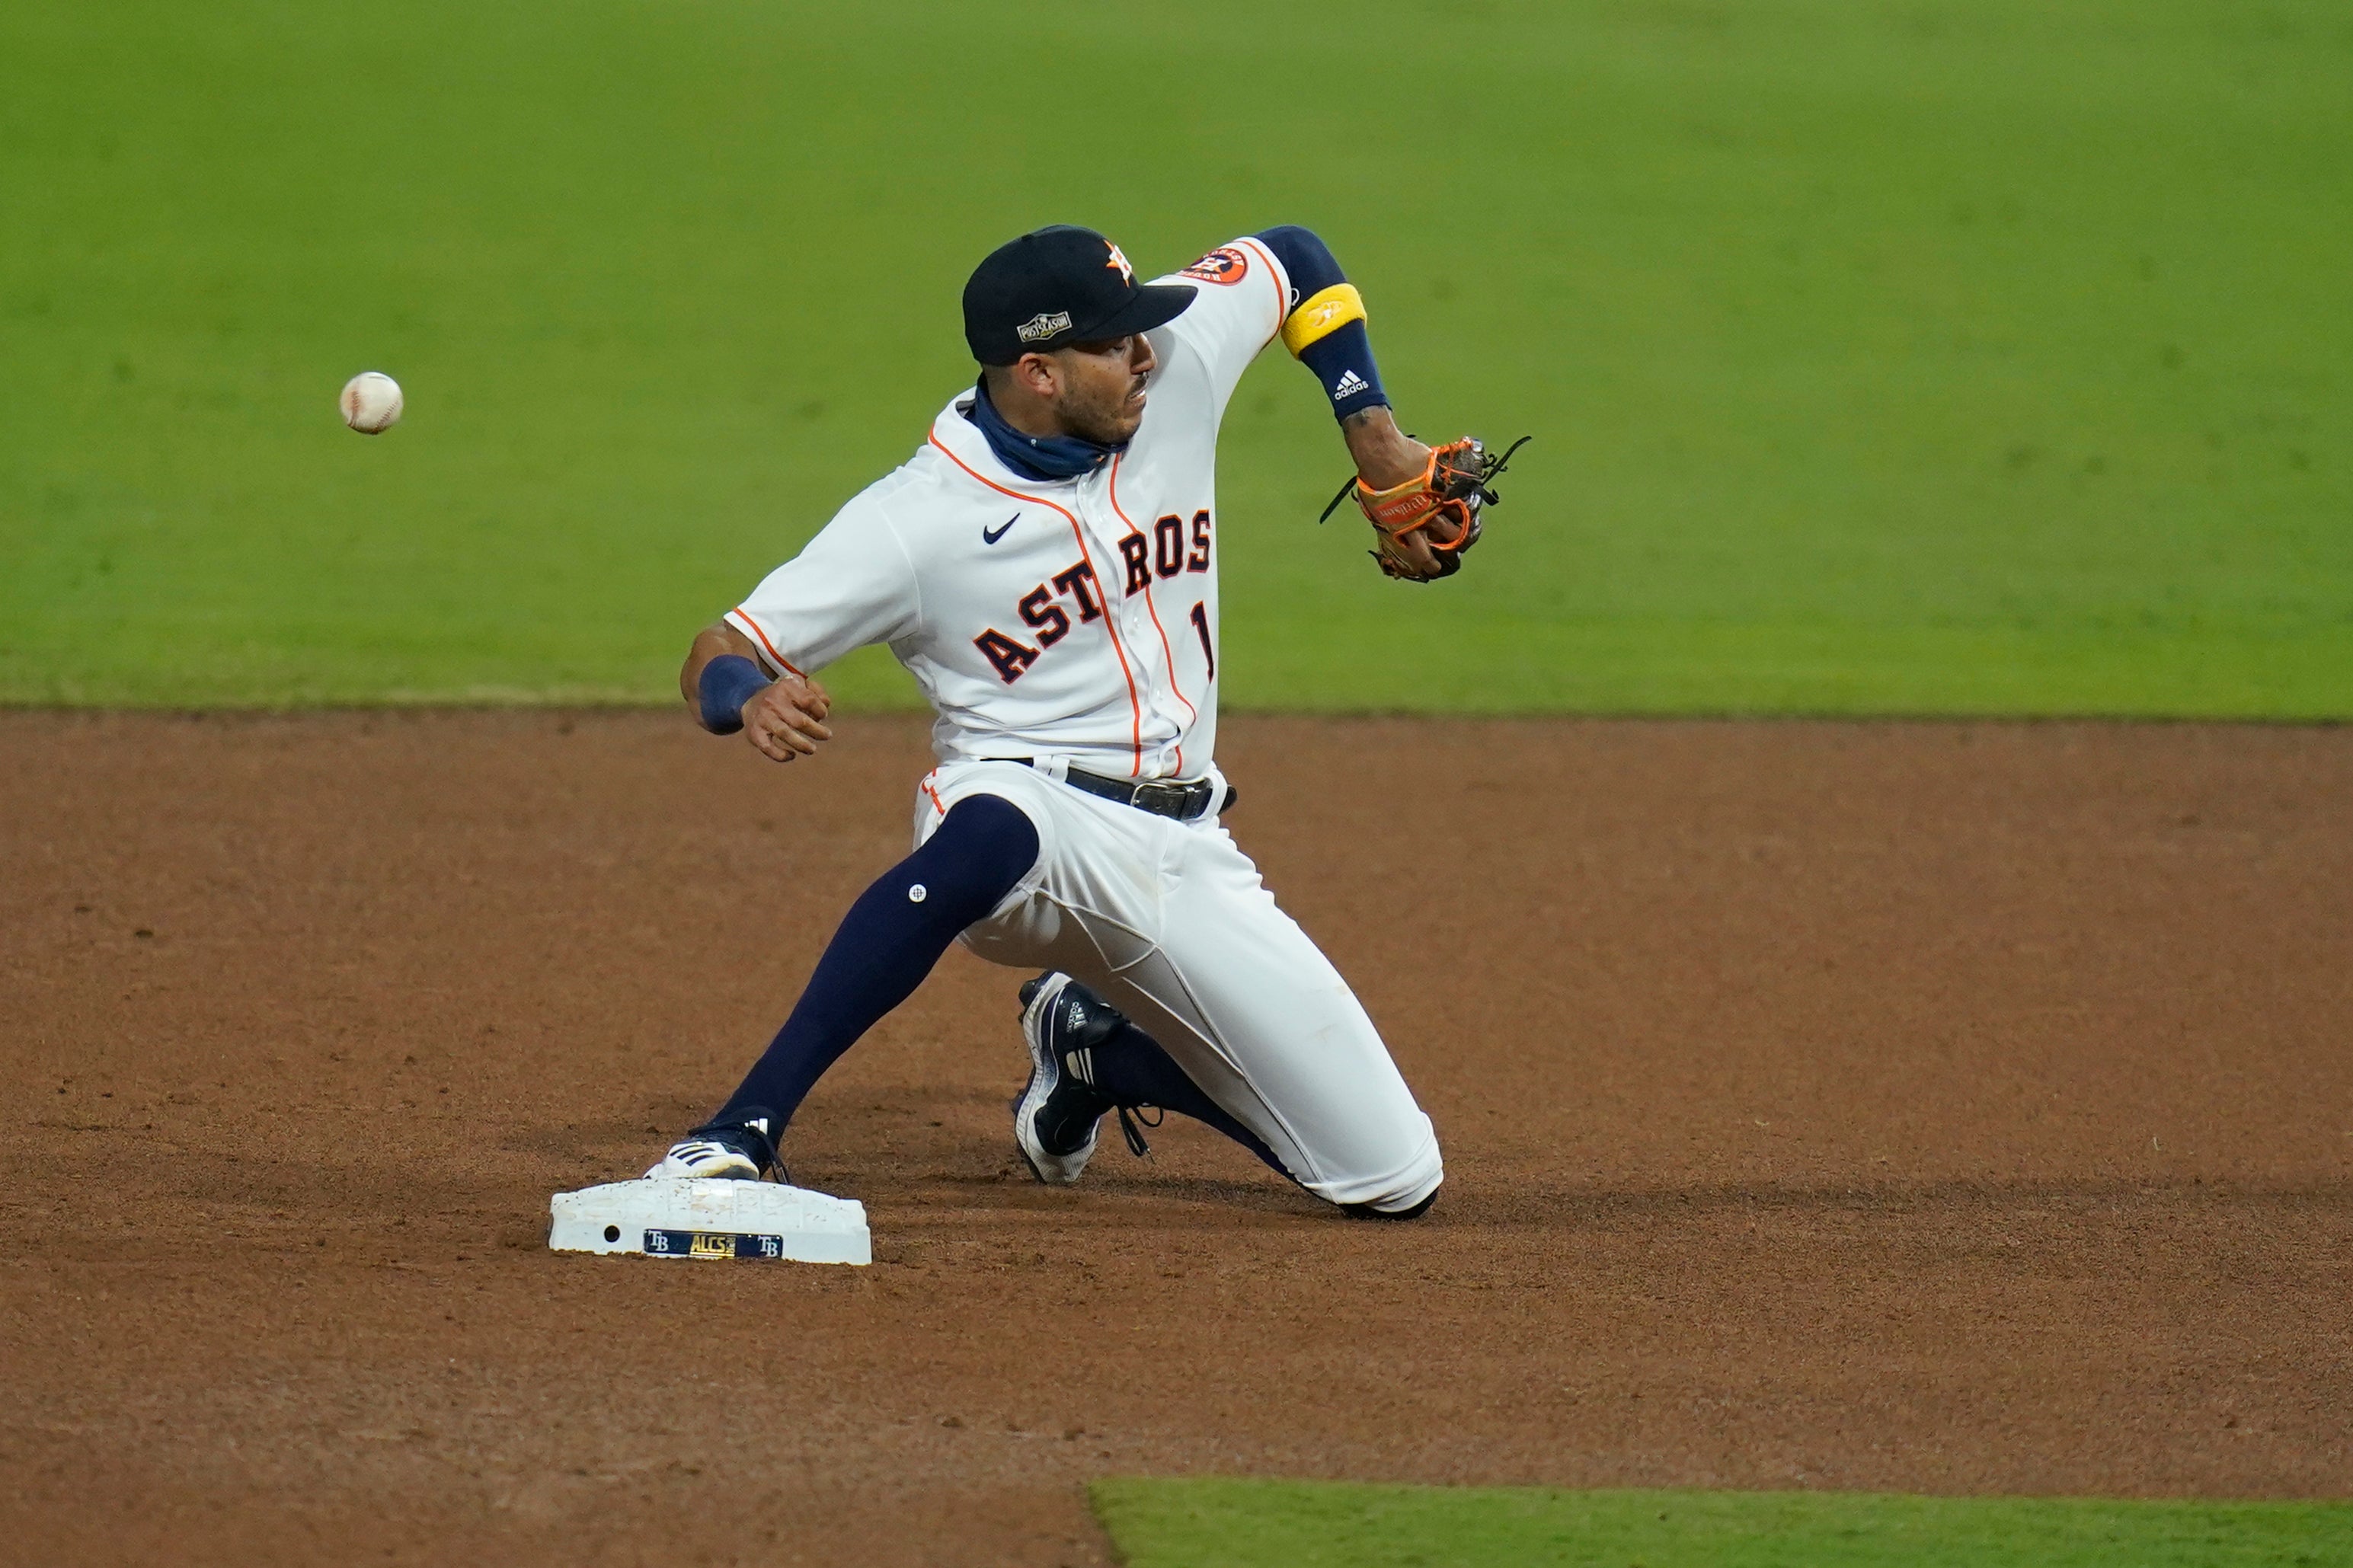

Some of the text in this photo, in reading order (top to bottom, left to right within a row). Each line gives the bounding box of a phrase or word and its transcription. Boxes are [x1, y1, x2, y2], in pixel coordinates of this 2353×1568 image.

[1334, 380, 1369, 401] adidas
[1379, 494, 1427, 517] Wilson
[647, 1230, 669, 1252] TB
[690, 1234, 726, 1253] ALCS
[757, 1235, 778, 1257] TB
